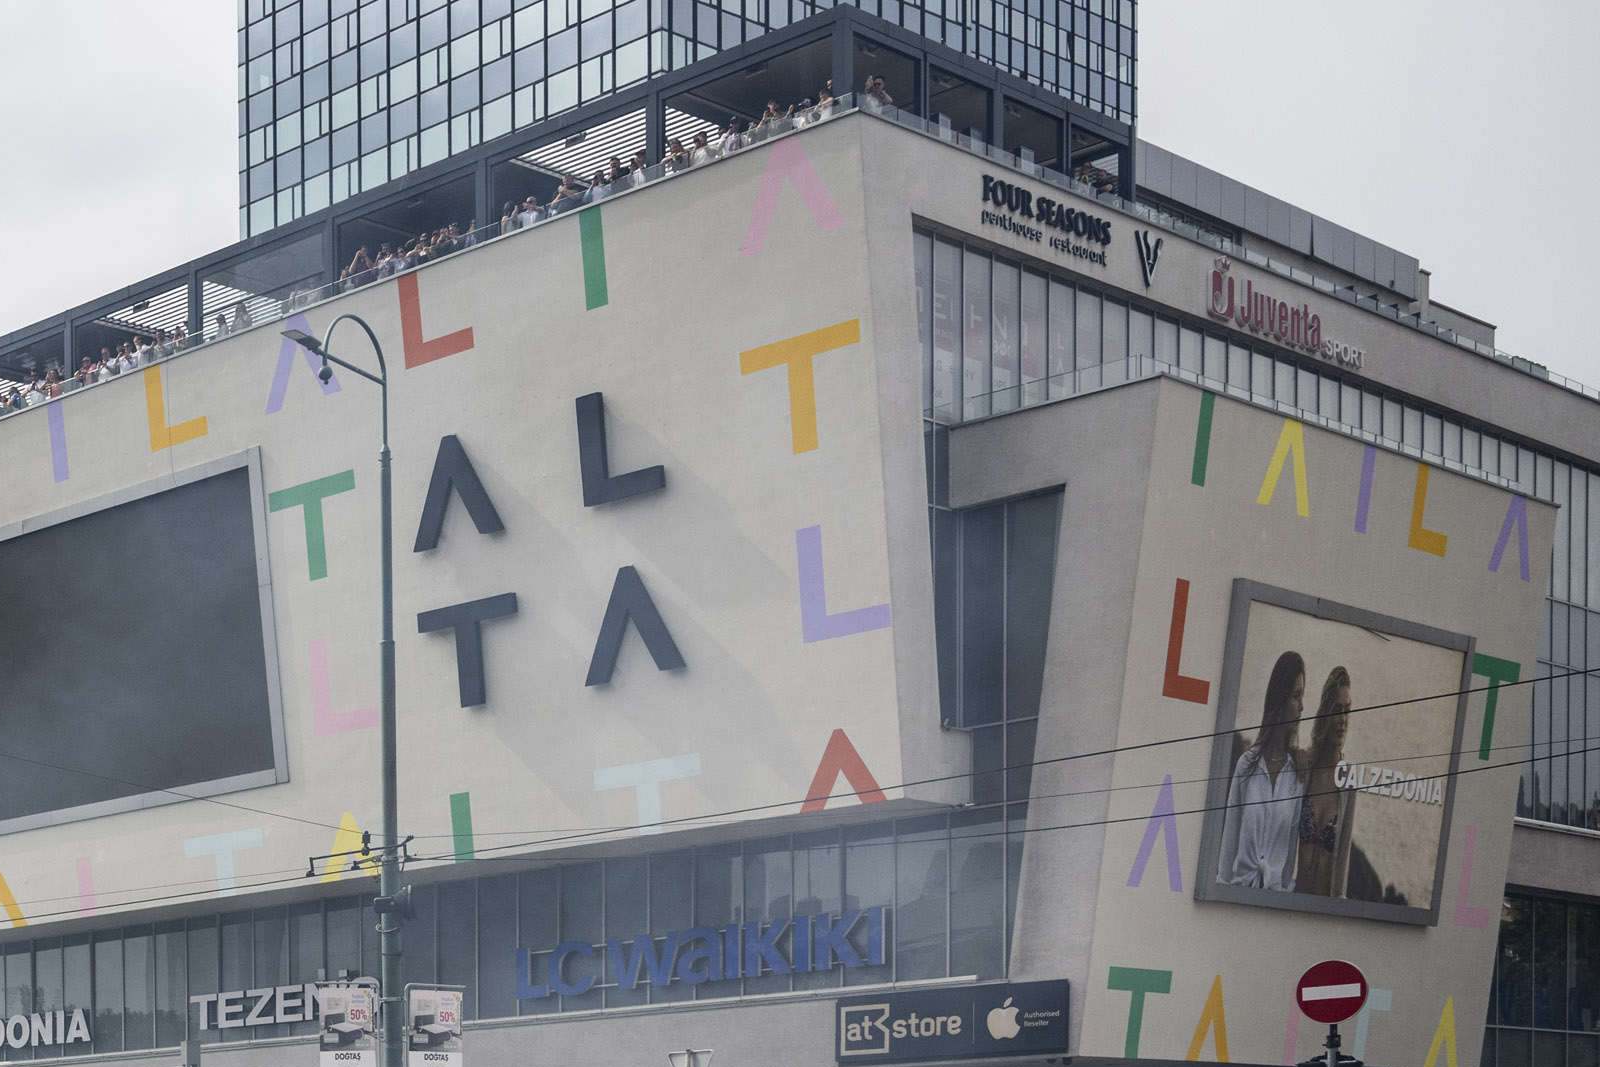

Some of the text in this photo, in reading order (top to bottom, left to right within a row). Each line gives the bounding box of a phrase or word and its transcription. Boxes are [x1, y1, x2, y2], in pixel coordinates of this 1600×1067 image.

[982, 175, 1112, 246] FOUR SEASONS
[981, 210, 1108, 266] penthouse restaurant
[1237, 279, 1321, 350] Juventa
[1324, 339, 1366, 369] SPORT
[1334, 760, 1443, 806] CALZEDONIA
[517, 941, 597, 999] LC
[350, 1009, 367, 1020] 50%
[439, 1011, 456, 1022] 50%
[892, 1012, 962, 1038] store
[1023, 1010, 1060, 1019] Authorised
[1023, 1019, 1050, 1028] Reseller
